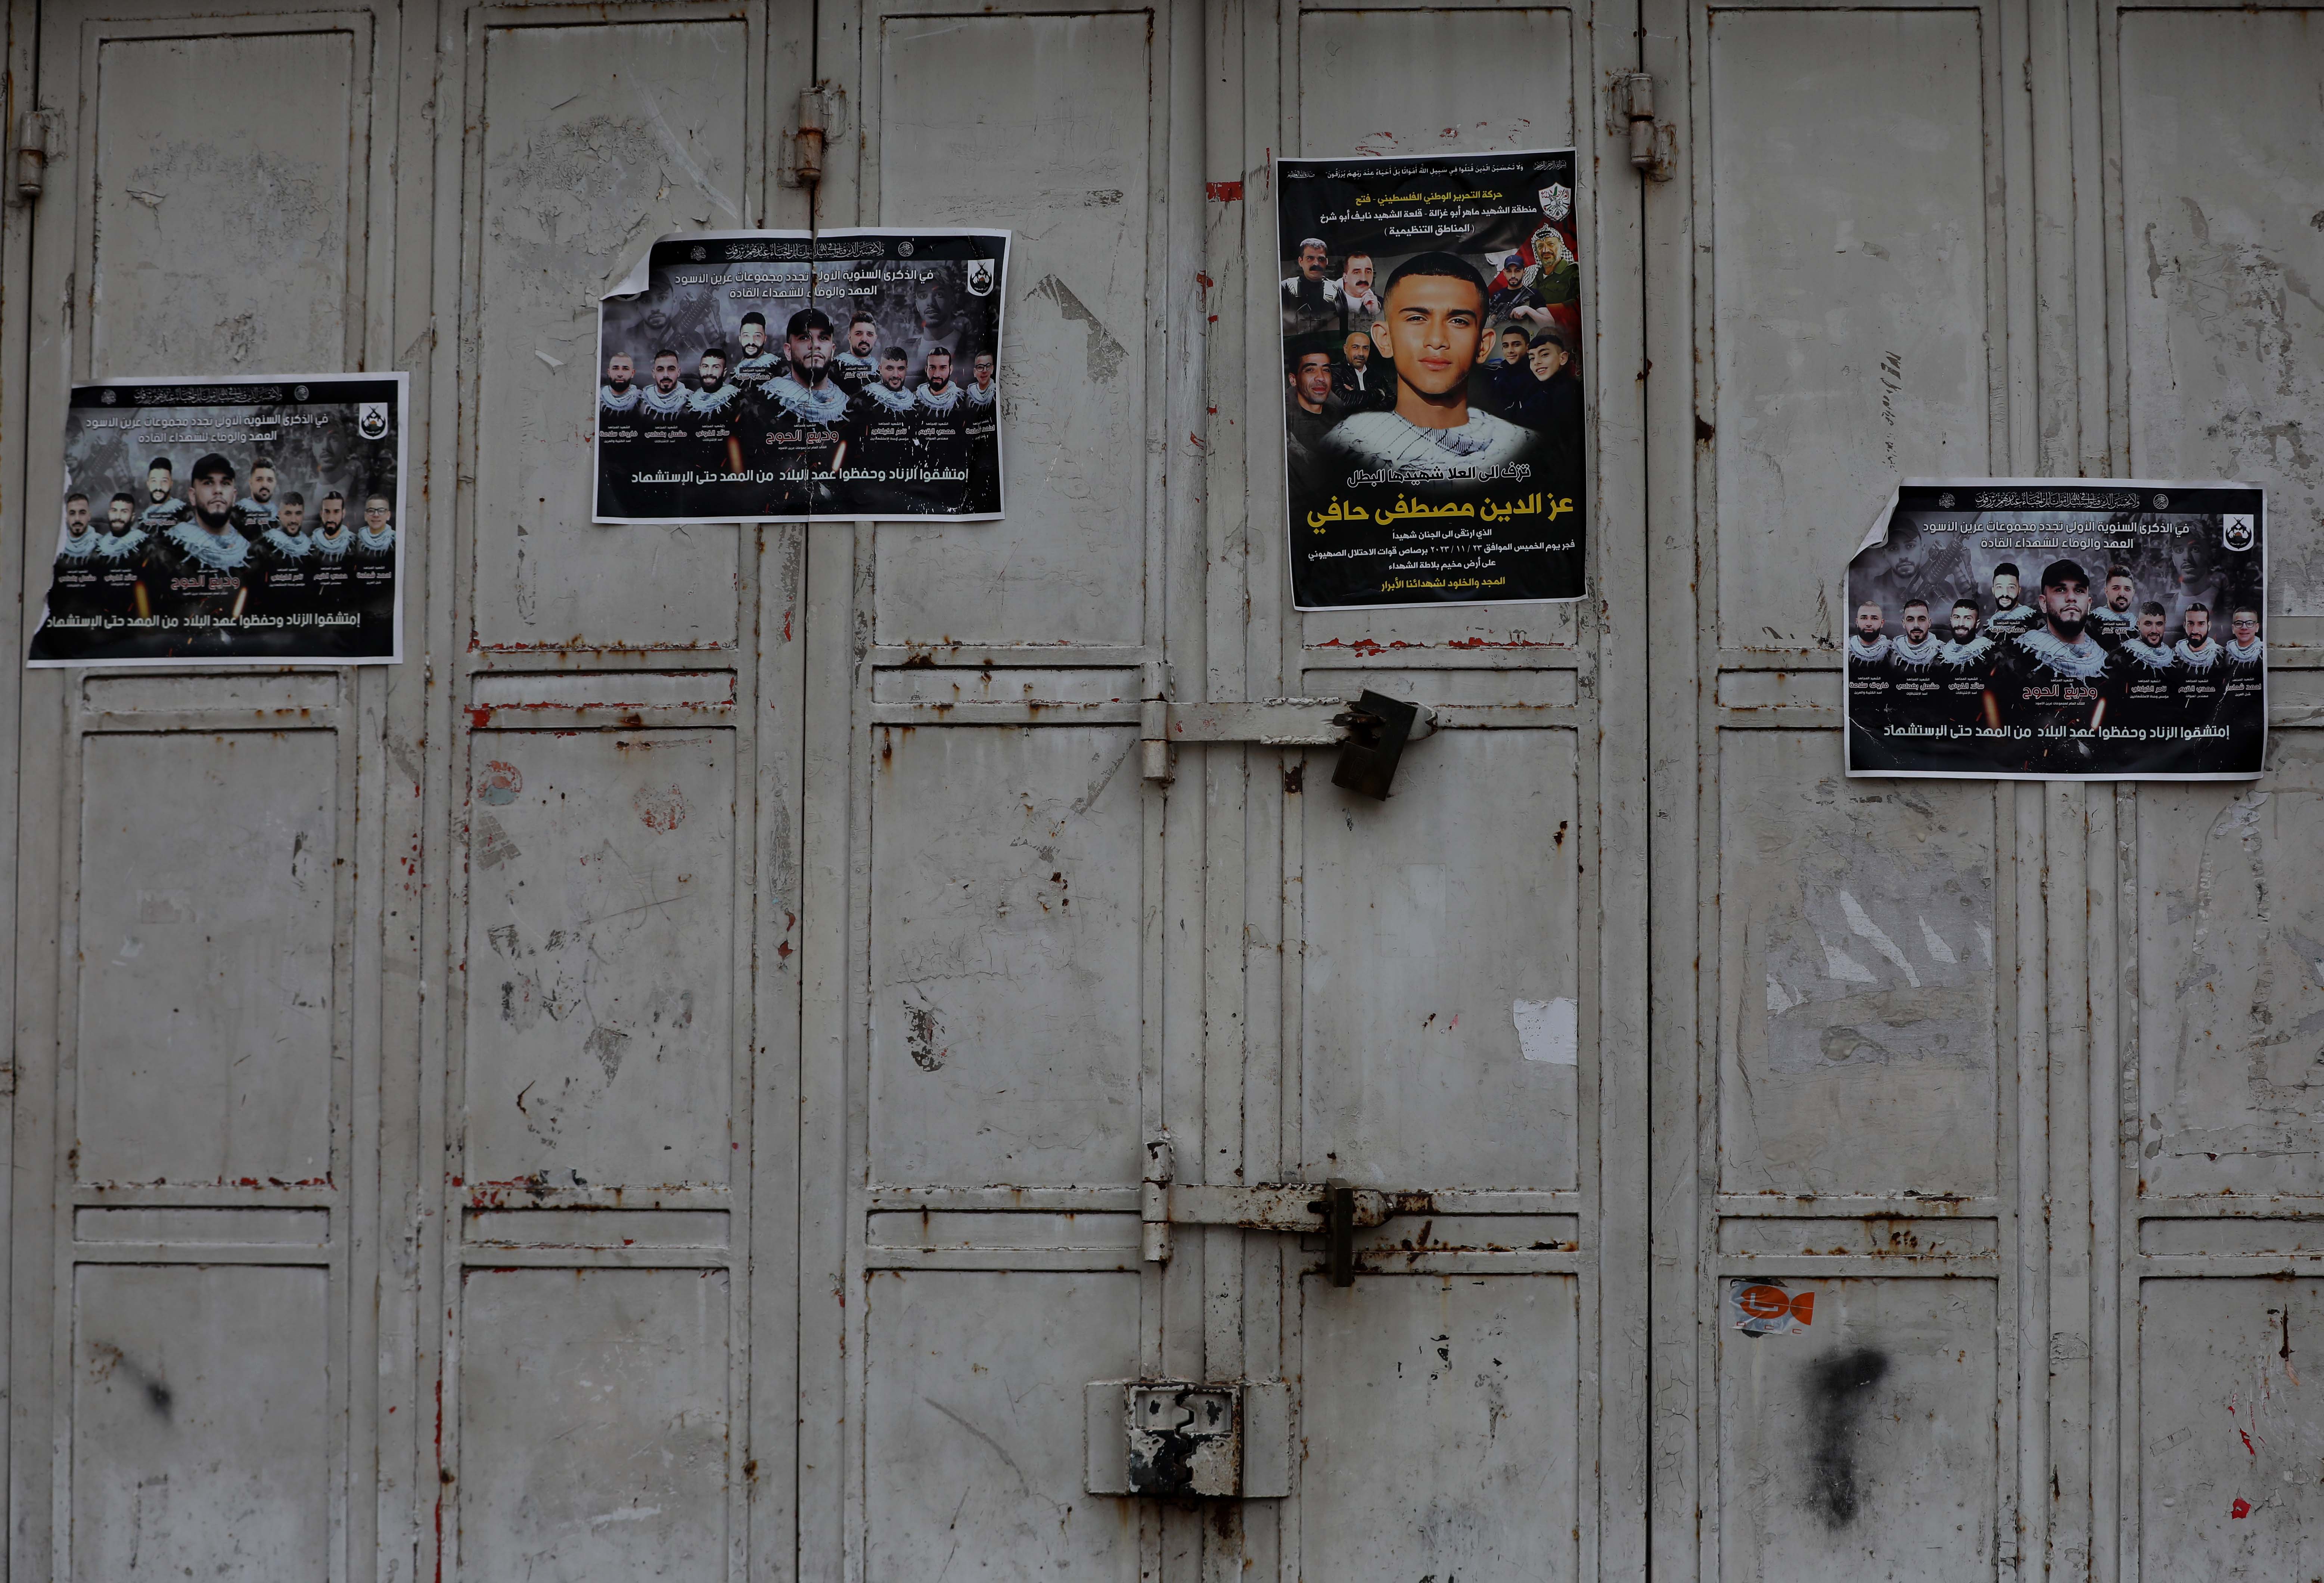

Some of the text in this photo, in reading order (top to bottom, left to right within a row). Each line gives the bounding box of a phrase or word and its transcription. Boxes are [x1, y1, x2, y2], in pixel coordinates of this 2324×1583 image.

[1355, 190, 1503, 206] حركة التحرير الوطني الفلسطيني فتح
[1320, 205, 1537, 224] منطقة الشهيد ماهر أبو غزالة قلعة الشهيد نايف أبو شرخ
[675, 273, 708, 286] الأسود
[711, 273, 733, 285] عرين
[736, 272, 783, 284] مجموعات
[786, 271, 809, 283] تجدد
[843, 269, 881, 282] السنوية
[883, 270, 916, 282] الذكرى
[919, 270, 934, 283] في
[730, 287, 759, 298] القادة
[762, 286, 804, 298] للشهداء
[848, 285, 877, 295] العهد
[120, 418, 141, 429] عرين
[145, 417, 189, 429] مجموعات
[191, 417, 213, 428] تجدد
[244, 414, 280, 427] السنوية
[283, 414, 313, 427] الذكرى
[315, 414, 328, 427] في
[138, 430, 277, 443] العهد والوفاء للشهداء القادة
[766, 429, 839, 444] وديع الحوح
[631, 469, 693, 485] الإستشهاد
[696, 470, 717, 485] حتى
[720, 469, 753, 481] المهد
[756, 469, 774, 483] من
[780, 469, 808, 483] البلاد
[811, 470, 836, 480] عهد
[839, 468, 886, 482] وحفظوا
[889, 468, 917, 482] الزناد
[1347, 468, 1385, 488] البطل
[1388, 466, 1444, 485] شهيدها
[1447, 466, 1476, 481] العلا
[1478, 464, 1499, 482] الى
[1307, 492, 1574, 534] عز الدين مصطفى حافي
[1419, 531, 1440, 540] الجنان
[1442, 530, 1453, 539] الى
[1454, 529, 1475, 538] ارتقى
[1476, 529, 1492, 539] الذي
[1923, 520, 2190, 538] في الذكرى السنوية الأولى تجدد مجموعات عرين الأسود
[1483, 542, 1512, 554] الموافق
[1514, 541, 1544, 553] الخميس
[1562, 539, 1575, 550] فجر
[1981, 536, 2133, 550] العهد والوفاء للشهداء القادة
[1308, 549, 1346, 561] الصهيوني
[1348, 548, 1376, 559] الاحتلال
[1377, 546, 1397, 557] قوات
[1399, 547, 1428, 556] برصاص
[1389, 557, 1496, 571] على أرض مخيم بلاطة الشهداء
[1381, 576, 1506, 592] المجد والخلود لشهدائنا الأبرار
[46, 611, 361, 630] إمتشقوا الزناد وحفظوا عهد البلاد من المهد حتى الإستشهاد
[2022, 684, 2098, 700] وديع الحوح
[1883, 723, 2230, 740] إمتشقوا الزناد وحفظوا عهد البلاد من المهد حتى الإستشهاد
